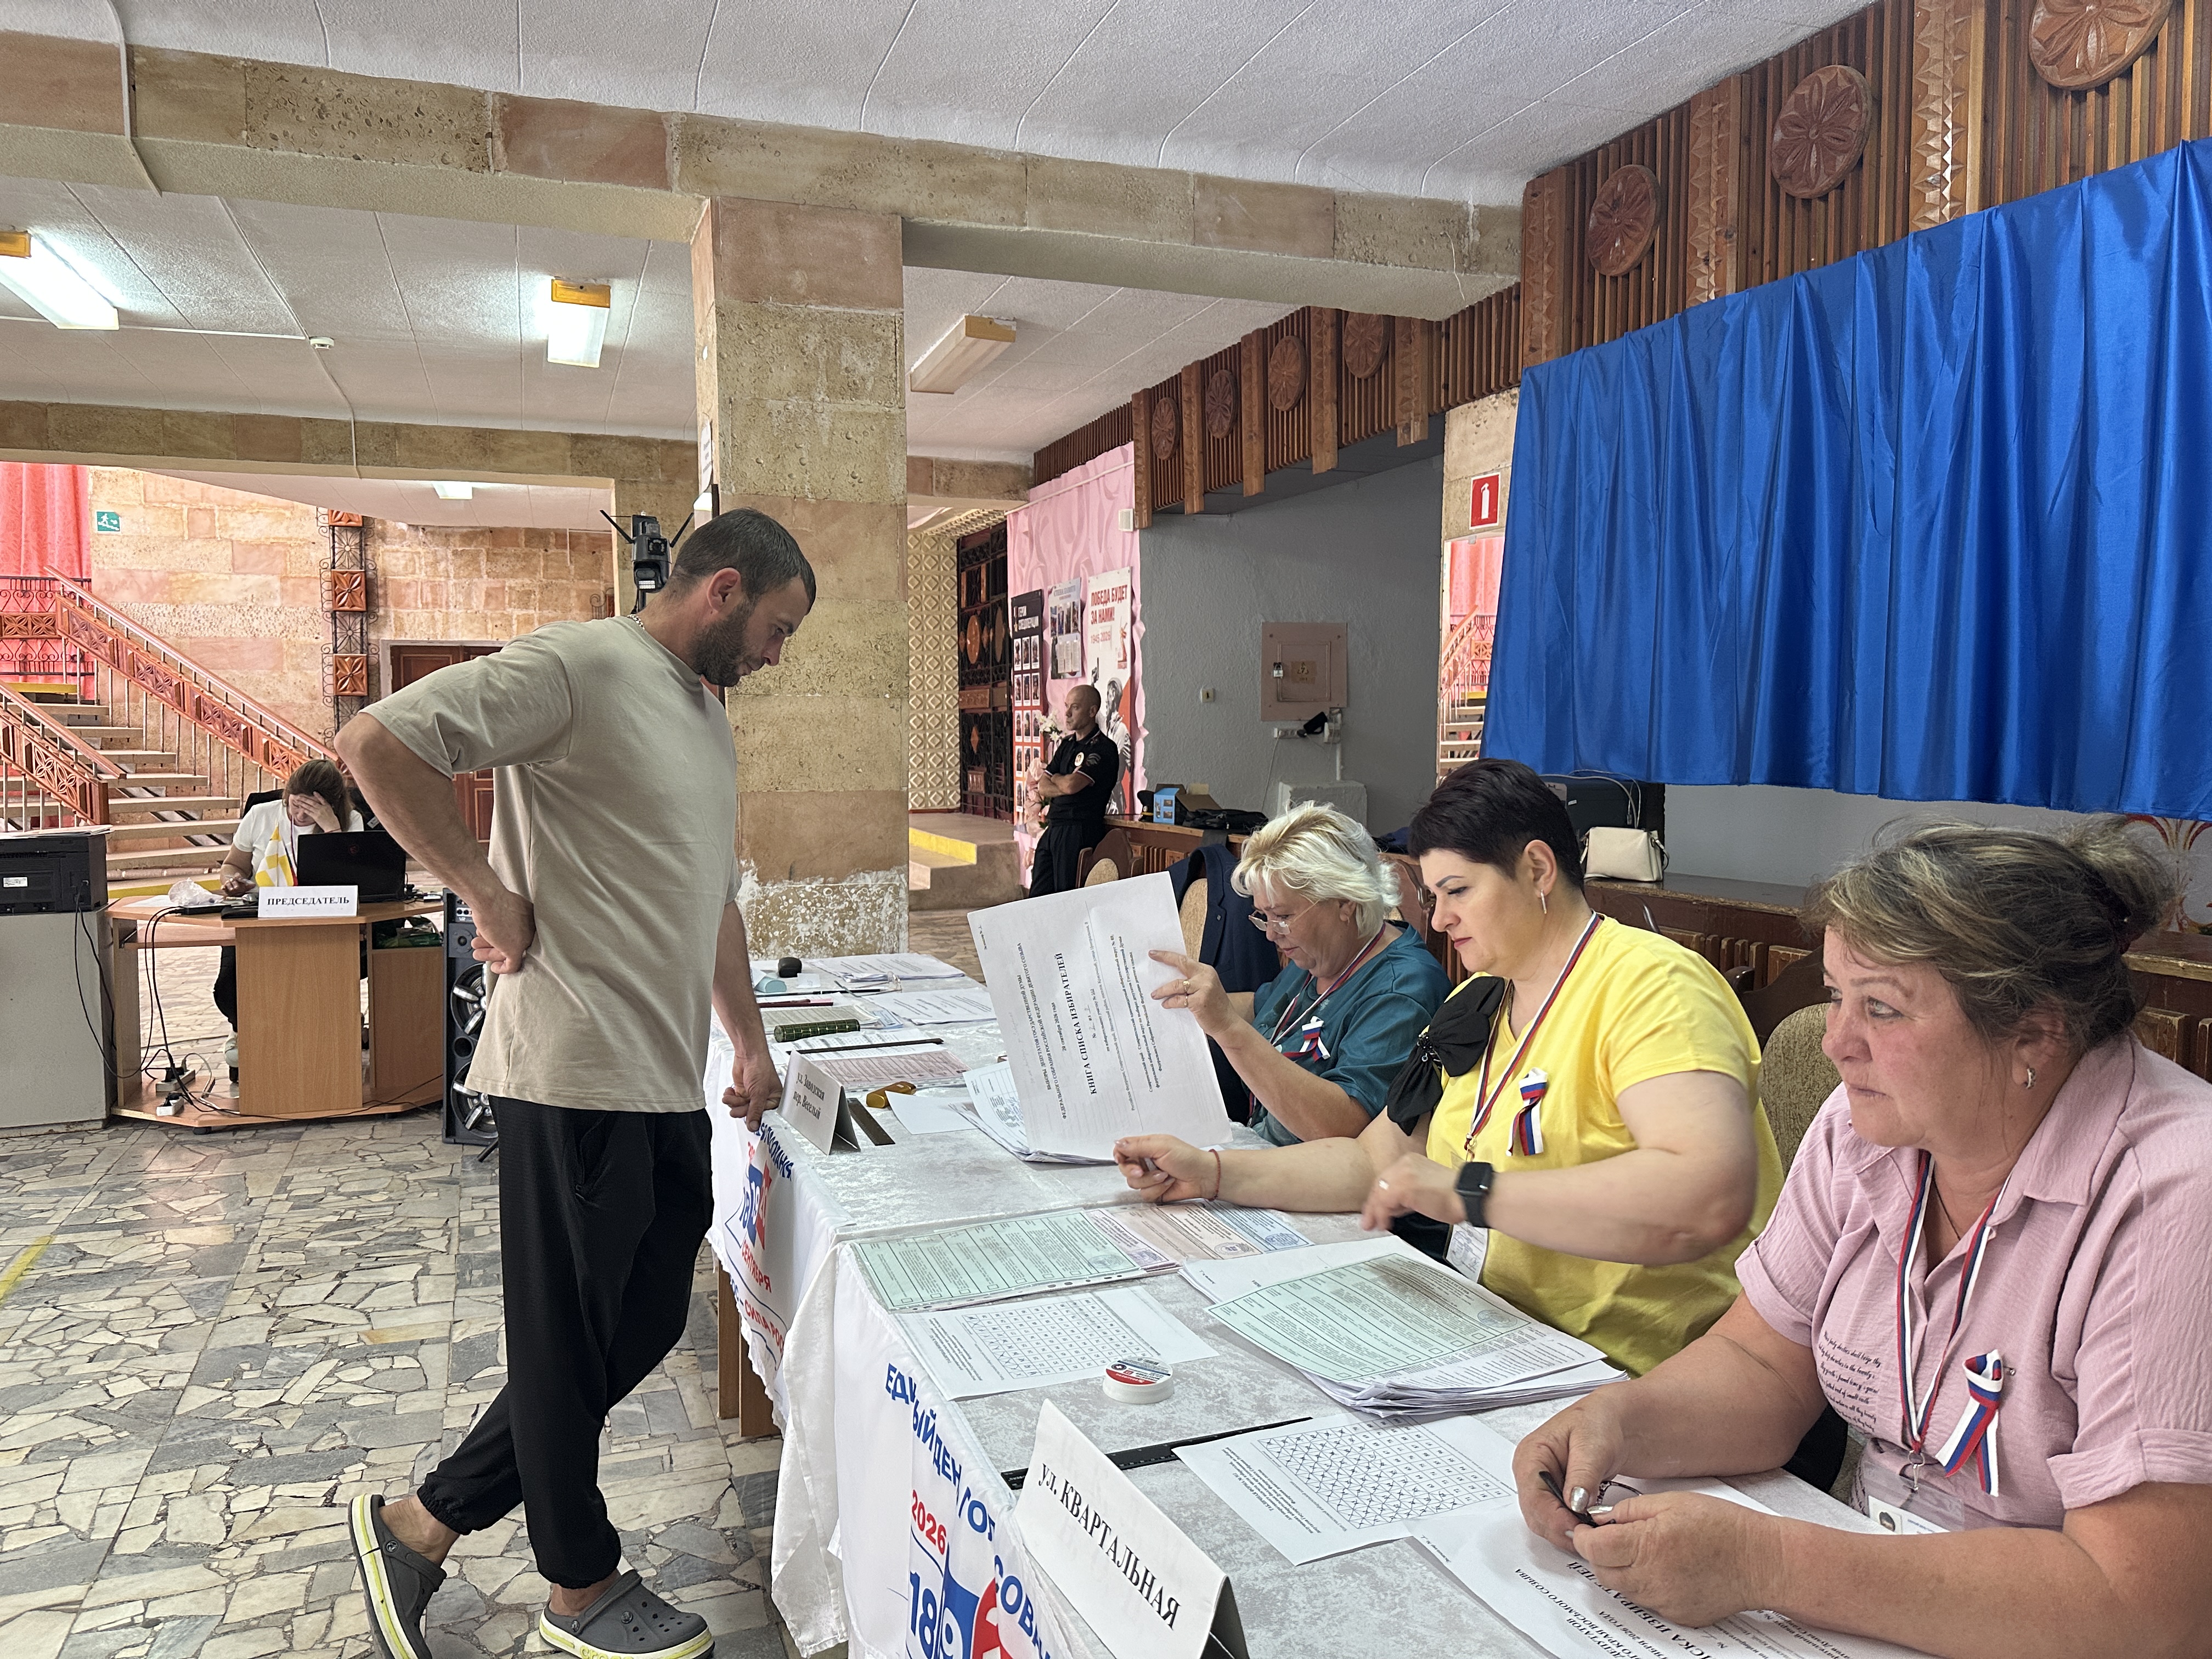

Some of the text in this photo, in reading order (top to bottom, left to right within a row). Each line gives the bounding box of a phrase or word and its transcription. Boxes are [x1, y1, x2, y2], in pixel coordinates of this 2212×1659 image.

[1091, 585, 1127, 606] ПОБЕДА БУДЕТ
[1091, 607, 1115, 625] ЗА НАМИ!
[1091, 634, 1100, 644] 1945
[268, 896, 349, 905] ПРЕДСЕДАТЕЛЬ
[1017, 943, 1066, 1119] ФЕДЕРАЛЬНОГО СОБРАНИЯ РОССИЙСКОЙ ФЕДЕРАЦИИ ДЕВЯТОГО СОЗЫВА
[1017, 975, 1051, 1090] ВЫБОРЫ ДЕПУТАТОВ ГОСУДАРСТВЕННОЙ ДУМЫ
[1054, 953, 1097, 1094] КНИГА СПИСКА ИЗБИРАТЕЛЕЙ
[802, 1095, 821, 1120] Веселый
[742, 1239, 772, 1293] СЕНТЯБРЯ
[745, 1299, 771, 1333] СИЛА
[885, 1363, 936, 1452] ЕДИЫЙ
[933, 1434, 961, 1505] ДЕН
[911, 1489, 947, 1555] 2026
[1039, 1463, 1181, 1630] ул. КВАРТАЛЬНАЯ
[910, 1570, 937, 1659] 18
[1514, 1568, 1625, 1650] КРАЯ ВОСЬМОГО СОЗЫВА
[1599, 1610, 1637, 1640] 2026 ГОДА
[1566, 1618, 1627, 1659] ДЕПУТАТОВ
